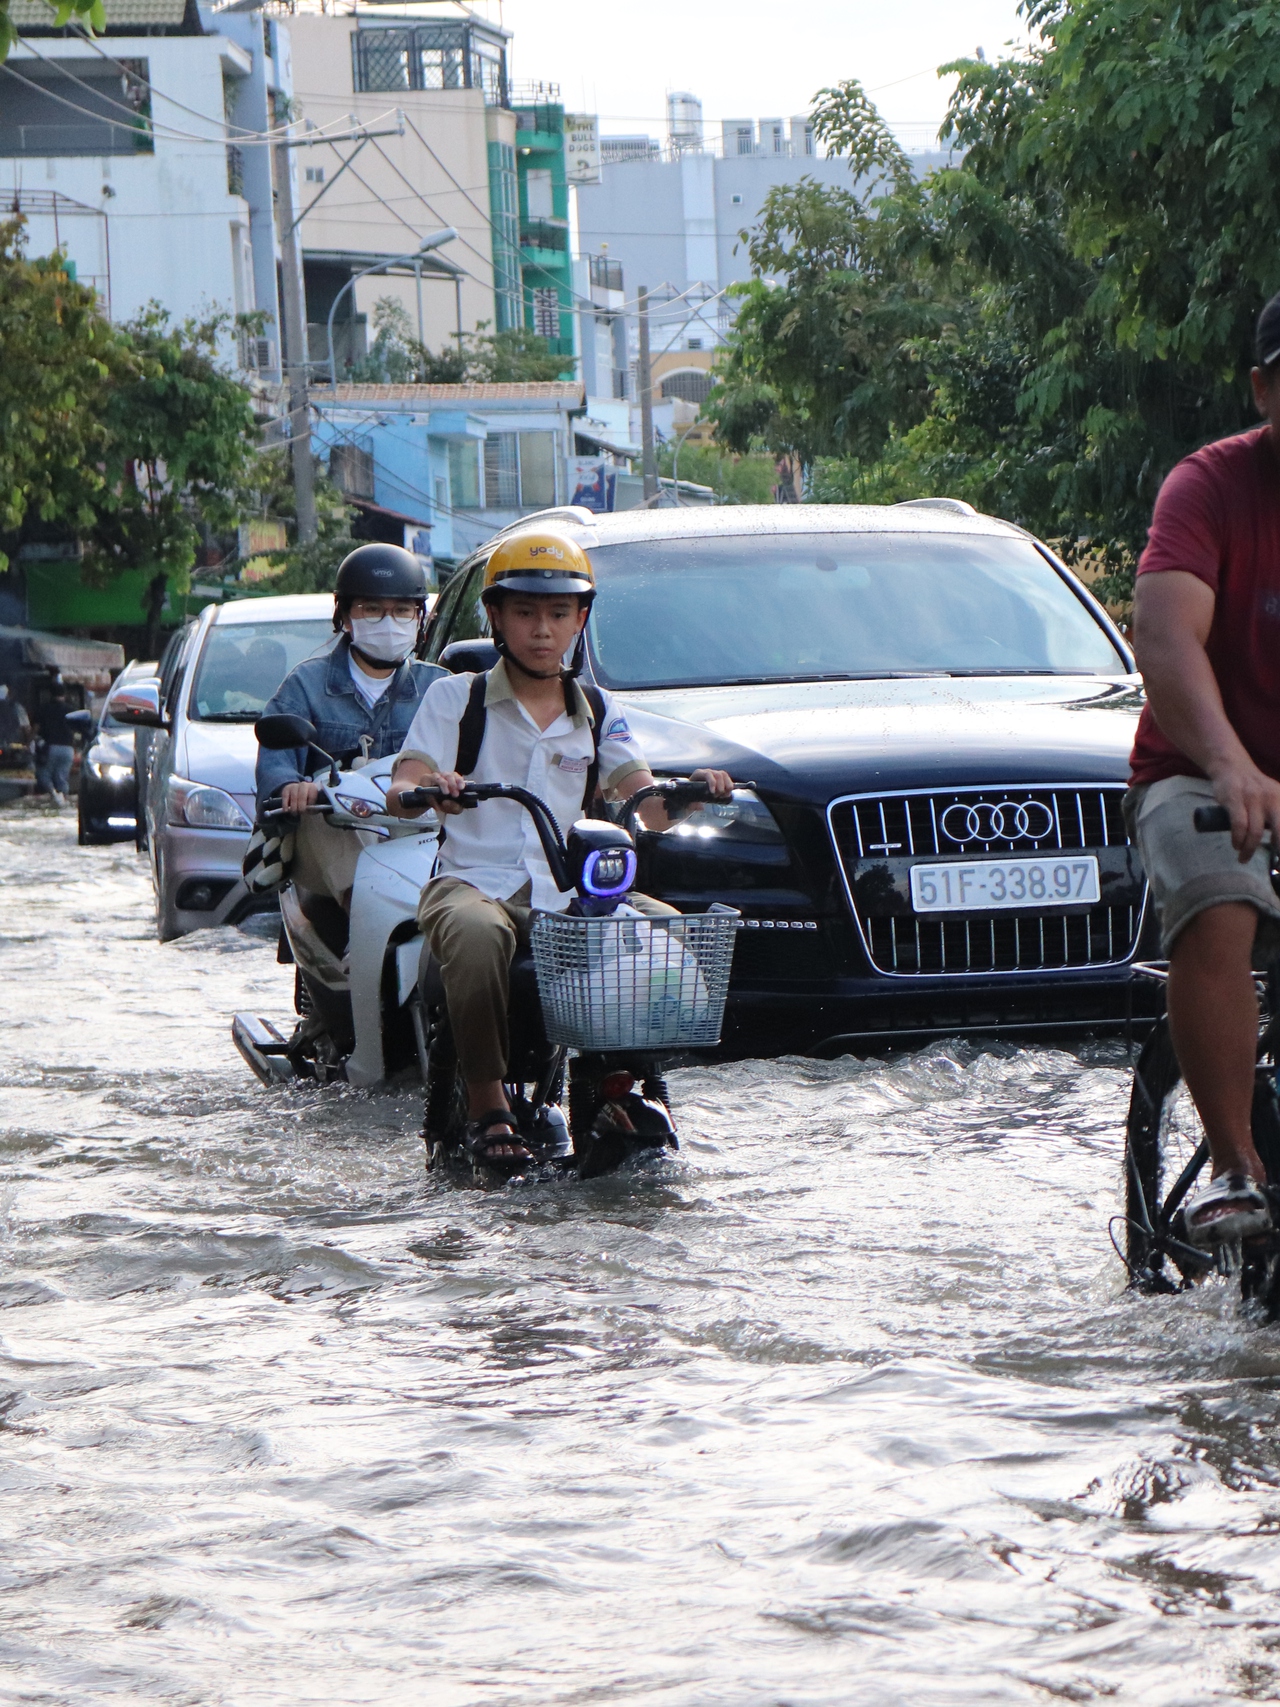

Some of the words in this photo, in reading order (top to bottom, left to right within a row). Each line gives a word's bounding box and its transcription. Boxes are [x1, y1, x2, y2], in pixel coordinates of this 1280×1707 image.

[577, 123, 595, 131] THE
[571, 133, 595, 142] BULL
[568, 144, 596, 153] DOGS
[530, 545, 564, 560] yody
[917, 862, 1090, 905] 51F-338.97
